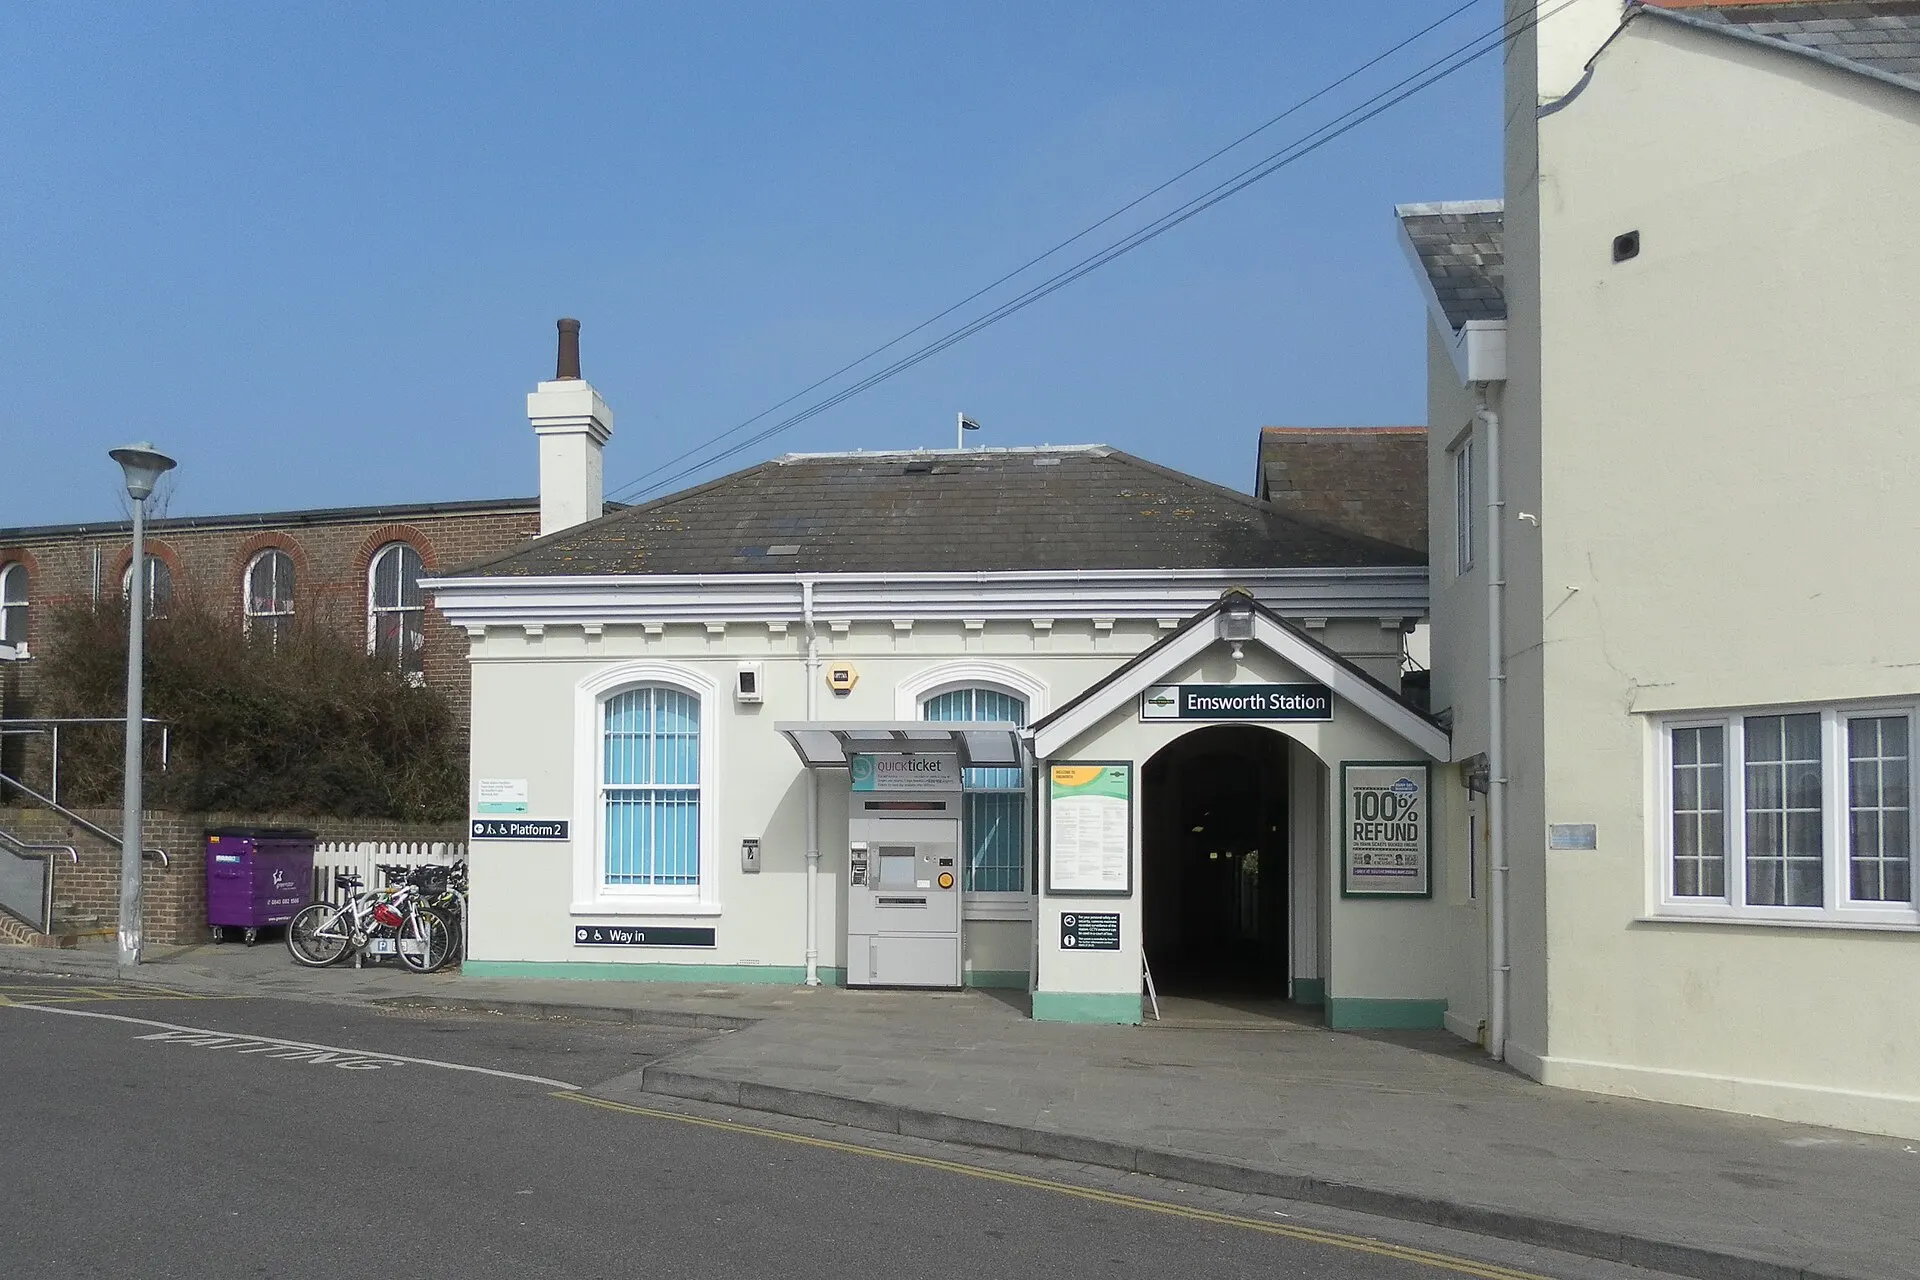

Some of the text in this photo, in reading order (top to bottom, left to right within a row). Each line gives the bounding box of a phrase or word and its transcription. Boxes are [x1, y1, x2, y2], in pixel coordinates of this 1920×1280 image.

[1187, 693, 1325, 710] Emsworth Station
[877, 759, 941, 772] QUICKticket
[1353, 791, 1418, 822] 100%
[510, 823, 561, 835] Platform 2
[1353, 822, 1418, 842] REFUND
[609, 930, 645, 944] Way in
[132, 1031, 405, 1070] WAITING
